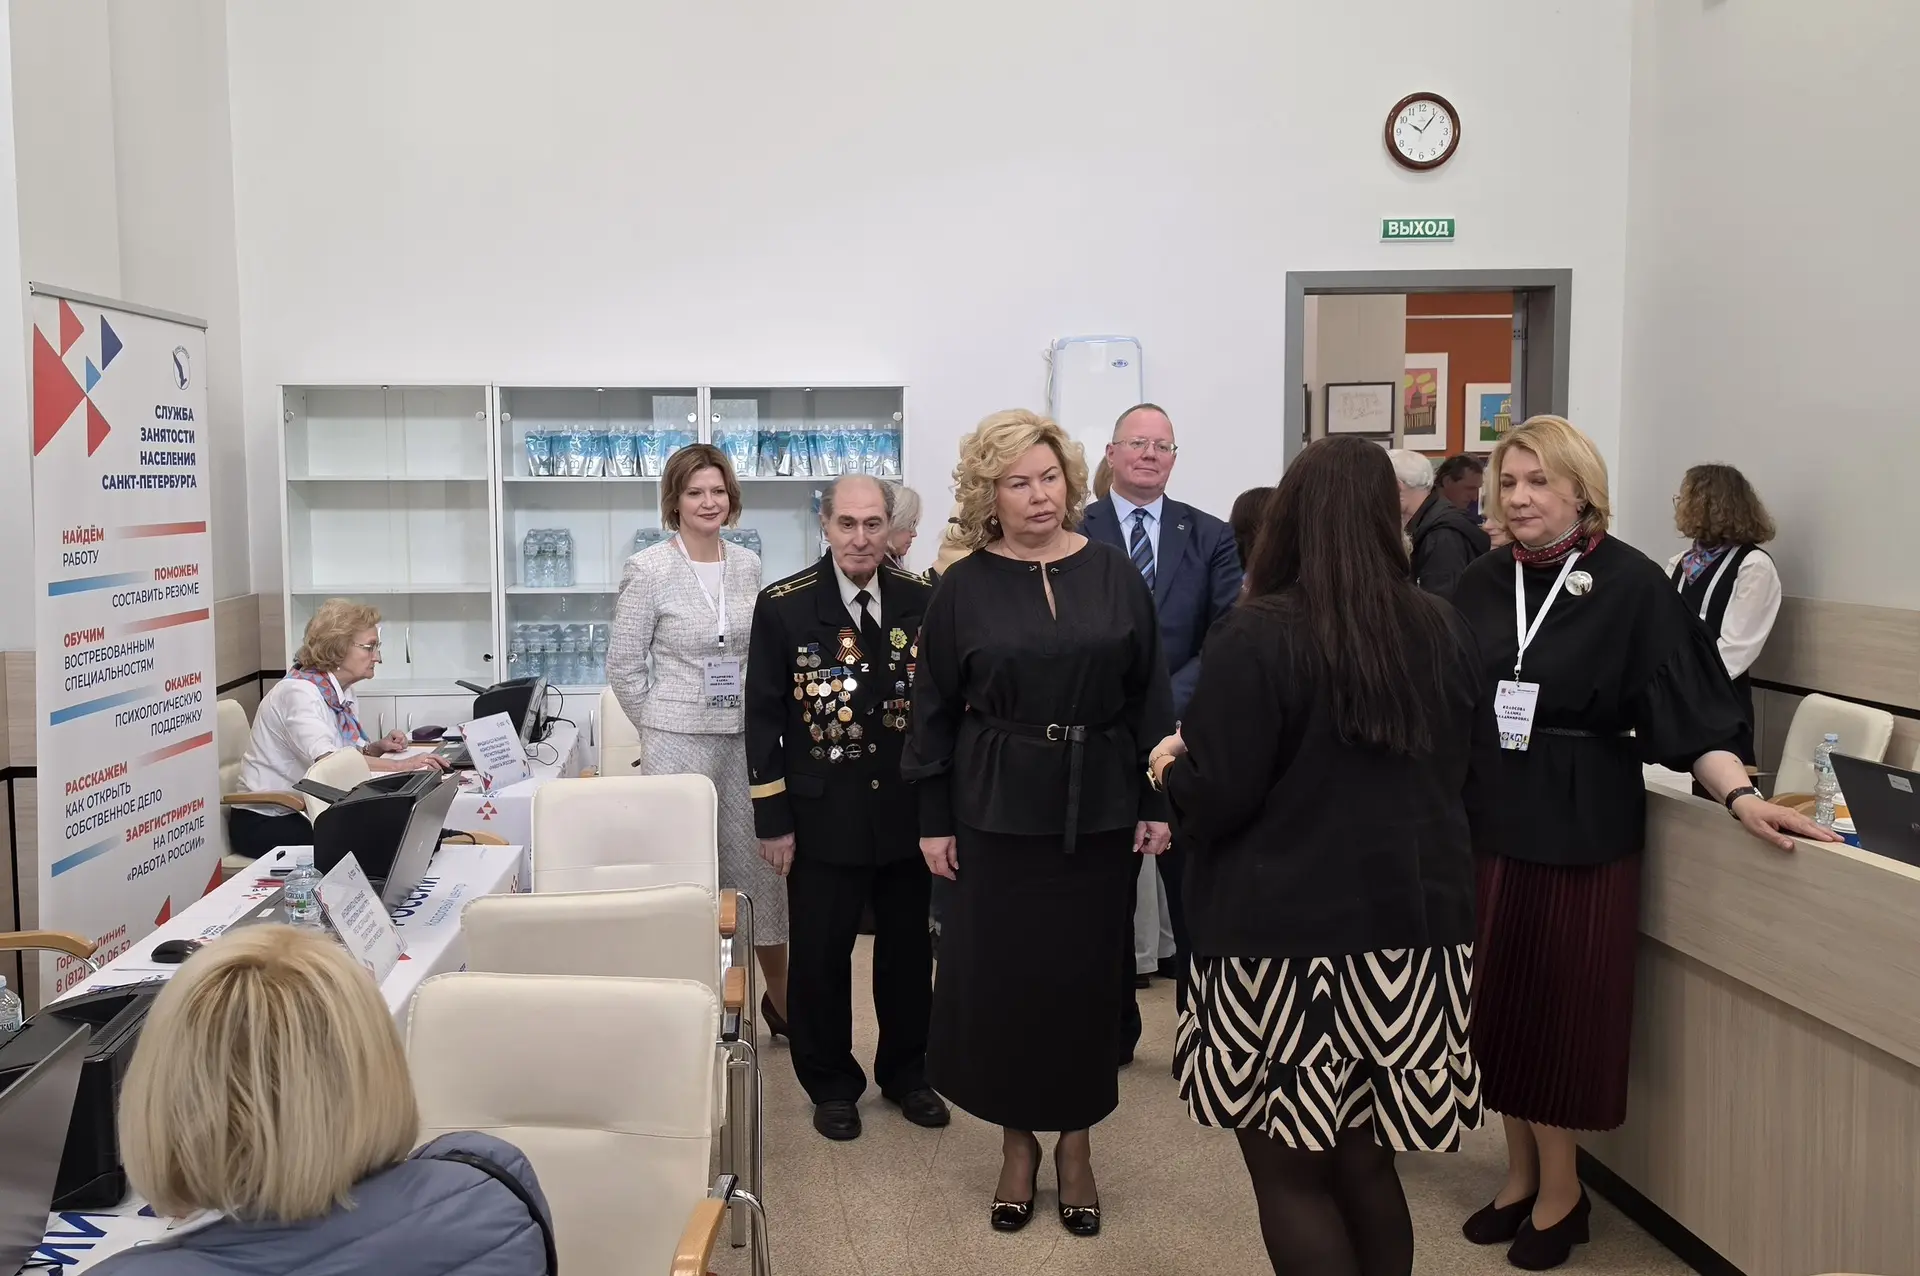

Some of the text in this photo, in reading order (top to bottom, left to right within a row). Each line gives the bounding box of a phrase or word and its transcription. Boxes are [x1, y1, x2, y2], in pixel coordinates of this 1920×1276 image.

[1408, 108, 1415, 116] 11
[1418, 104, 1427, 112] 12
[1400, 116, 1408, 124] 10
[1396, 128, 1402, 136] 9
[1408, 148, 1413, 156] 7
[1418, 152, 1424, 160] 6
[1431, 148, 1436, 156] 5
[1388, 221, 1449, 236] ВЫХОД
[155, 404, 194, 421] СЛУЖБА
[140, 427, 195, 443] ЗАНЯТОСТИ
[140, 451, 196, 466] НАСЕЛЕНИЯ
[102, 474, 197, 490] САНКТ-ПЕТЕРБУРГА
[62, 525, 104, 545] НАЙДЁМ
[62, 550, 99, 567] РАБОТУ
[154, 564, 198, 581] ПОМОЖЕМ
[112, 582, 199, 608] СОСТАВИТЬ РЕЗЮМЕ
[64, 627, 104, 648] ОБУЧИМ
[64, 638, 155, 670] ВОСТРЕБОВАННЫМ
[64, 658, 154, 692] СПЕЦИАЛЬНОСТЯМ
[165, 672, 201, 692] ОКАЖЕМ
[115, 690, 202, 727] ПСИХОЛОГИЧЕСКУЮ
[151, 709, 203, 736] ПОДДЕРЖКУ
[65, 761, 128, 796] РАССКАЖЕМ
[65, 781, 131, 818] КАК ОТКРЫТЬ
[65, 789, 162, 839] СОБСТВЕННОЕ ДЕЛО
[126, 797, 204, 842] ЗАРЕГИСТРИРУЕМ
[153, 816, 204, 850] НА ПОРТАЛЕ
[127, 837, 205, 882] «РАБОТА РОССИИ»
[56, 979, 62, 992] 8
[65, 965, 86, 991] (812)
[108, 946, 118, 963] 06
